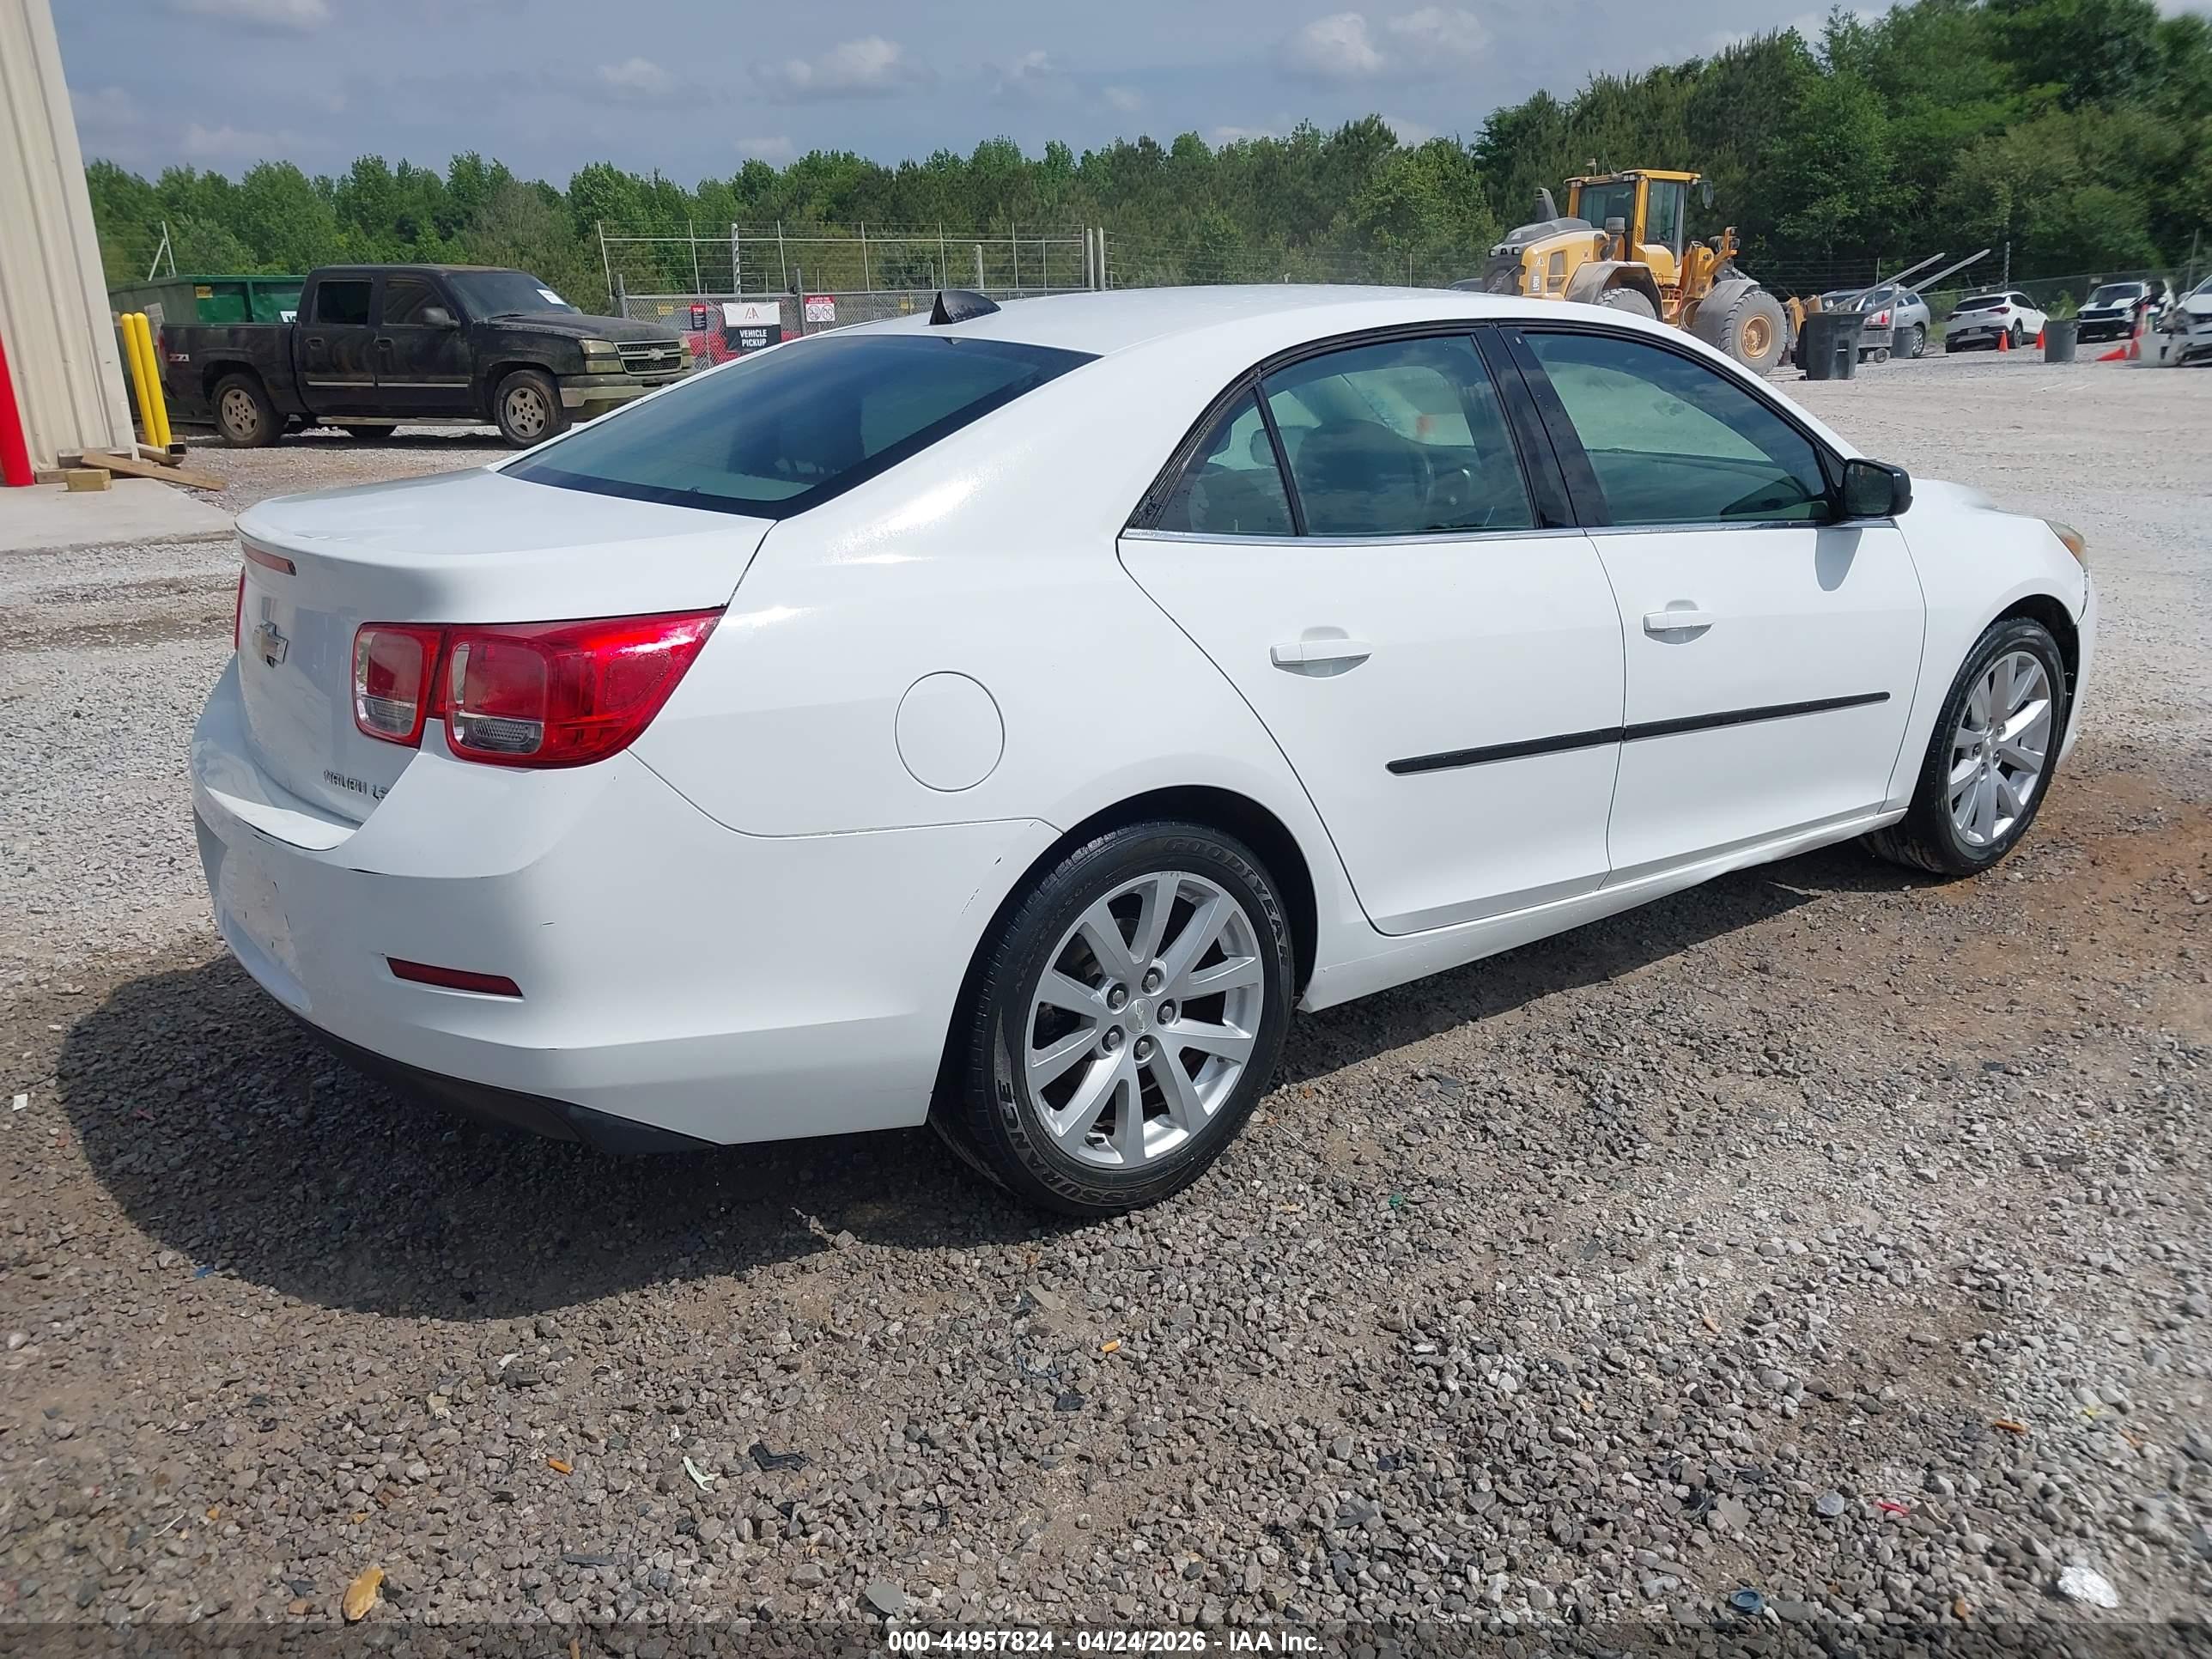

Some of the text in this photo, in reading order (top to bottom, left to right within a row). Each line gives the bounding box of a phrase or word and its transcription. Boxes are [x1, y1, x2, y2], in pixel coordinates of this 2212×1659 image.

[739, 329, 768, 338] VEHICLE
[741, 338, 767, 348] PICKUP
[323, 769, 368, 795] MALIBU
